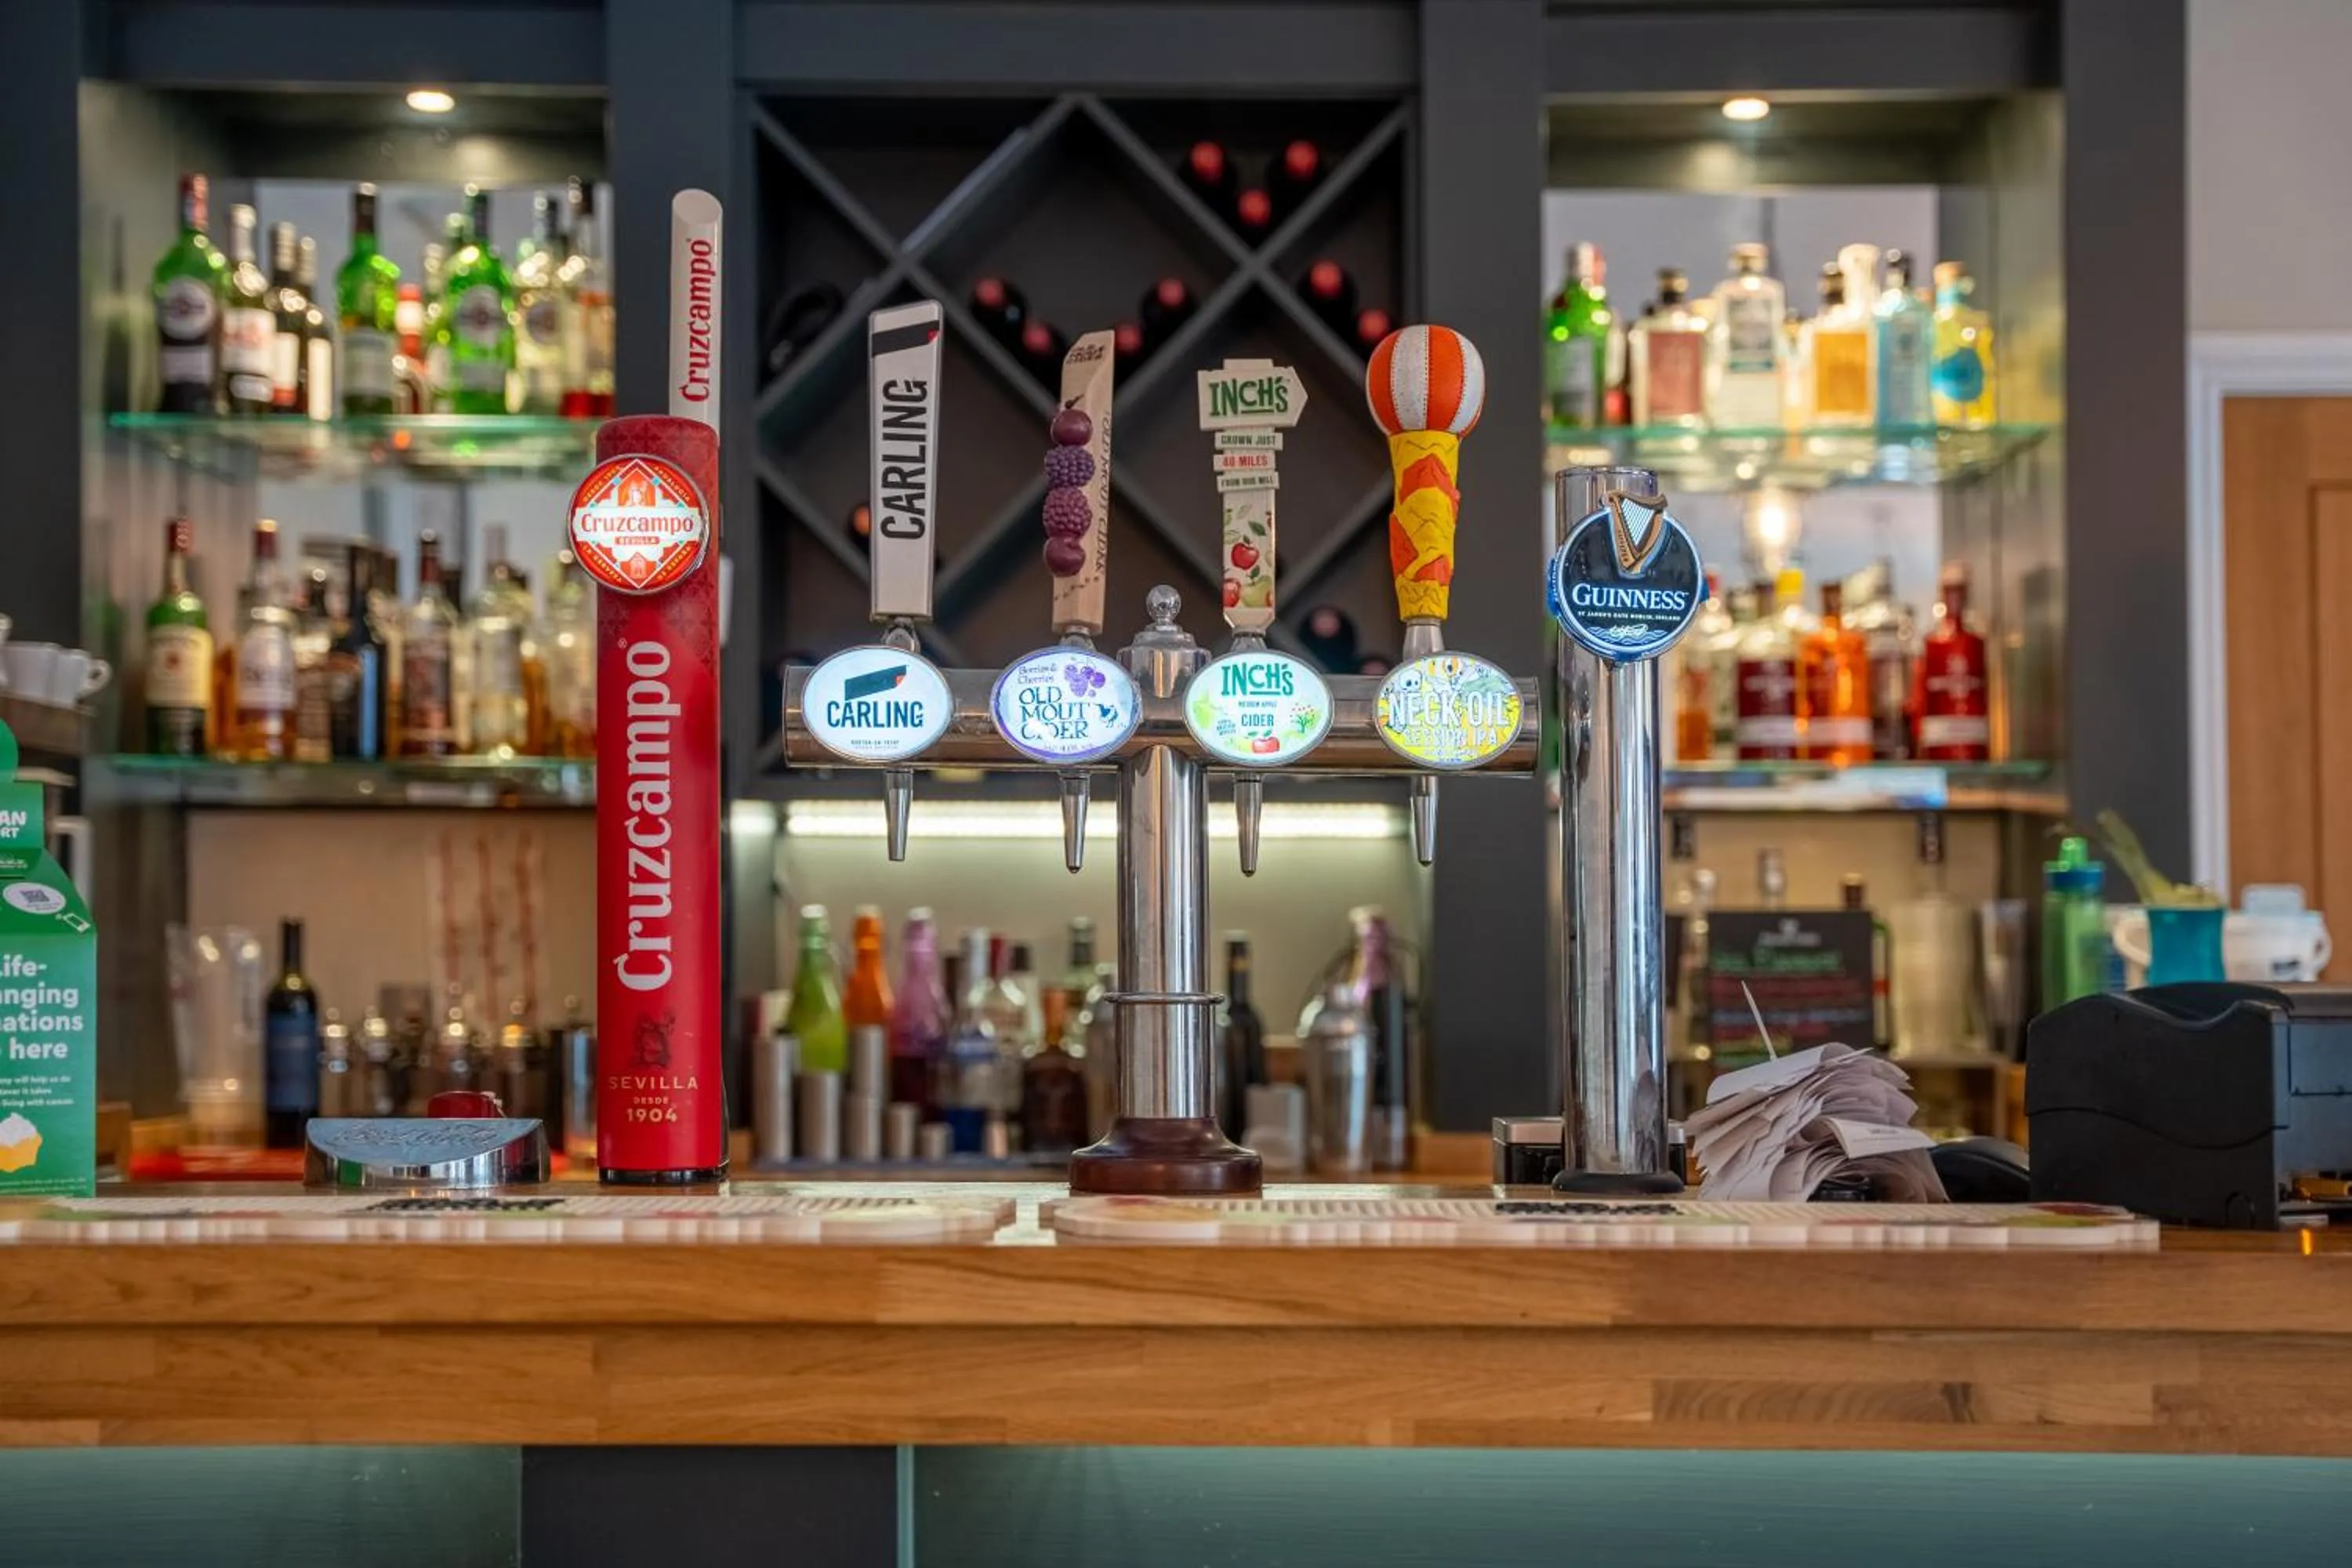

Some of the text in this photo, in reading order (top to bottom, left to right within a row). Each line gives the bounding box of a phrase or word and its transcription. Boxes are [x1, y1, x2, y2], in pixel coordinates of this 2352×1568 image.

[680, 238, 716, 402] Cruzcampo
[1221, 435, 1276, 445] GROWN JUST
[880, 379, 927, 539] CARLING
[1222, 454, 1269, 467] 40 MILES
[581, 514, 694, 535] Cruzcampo
[1572, 583, 1686, 610] GUINNESS
[1019, 686, 1062, 705] OLD
[827, 700, 924, 728] CARLING
[1019, 702, 1090, 721] MOUT
[1241, 713, 1274, 727] CIDER
[1388, 691, 1509, 728] NECK OIL
[1022, 721, 1089, 739] CDER
[1474, 728, 1497, 746] IPA
[615, 641, 681, 991] Cruzcampo
[0, 953, 47, 977] ife-
[0, 981, 78, 1009] nging
[0, 1009, 84, 1032] ations
[9, 1036, 68, 1059] here
[609, 1076, 699, 1090] SEVILLA
[633, 1096, 669, 1105] DESDE
[626, 1108, 678, 1122] 1904
